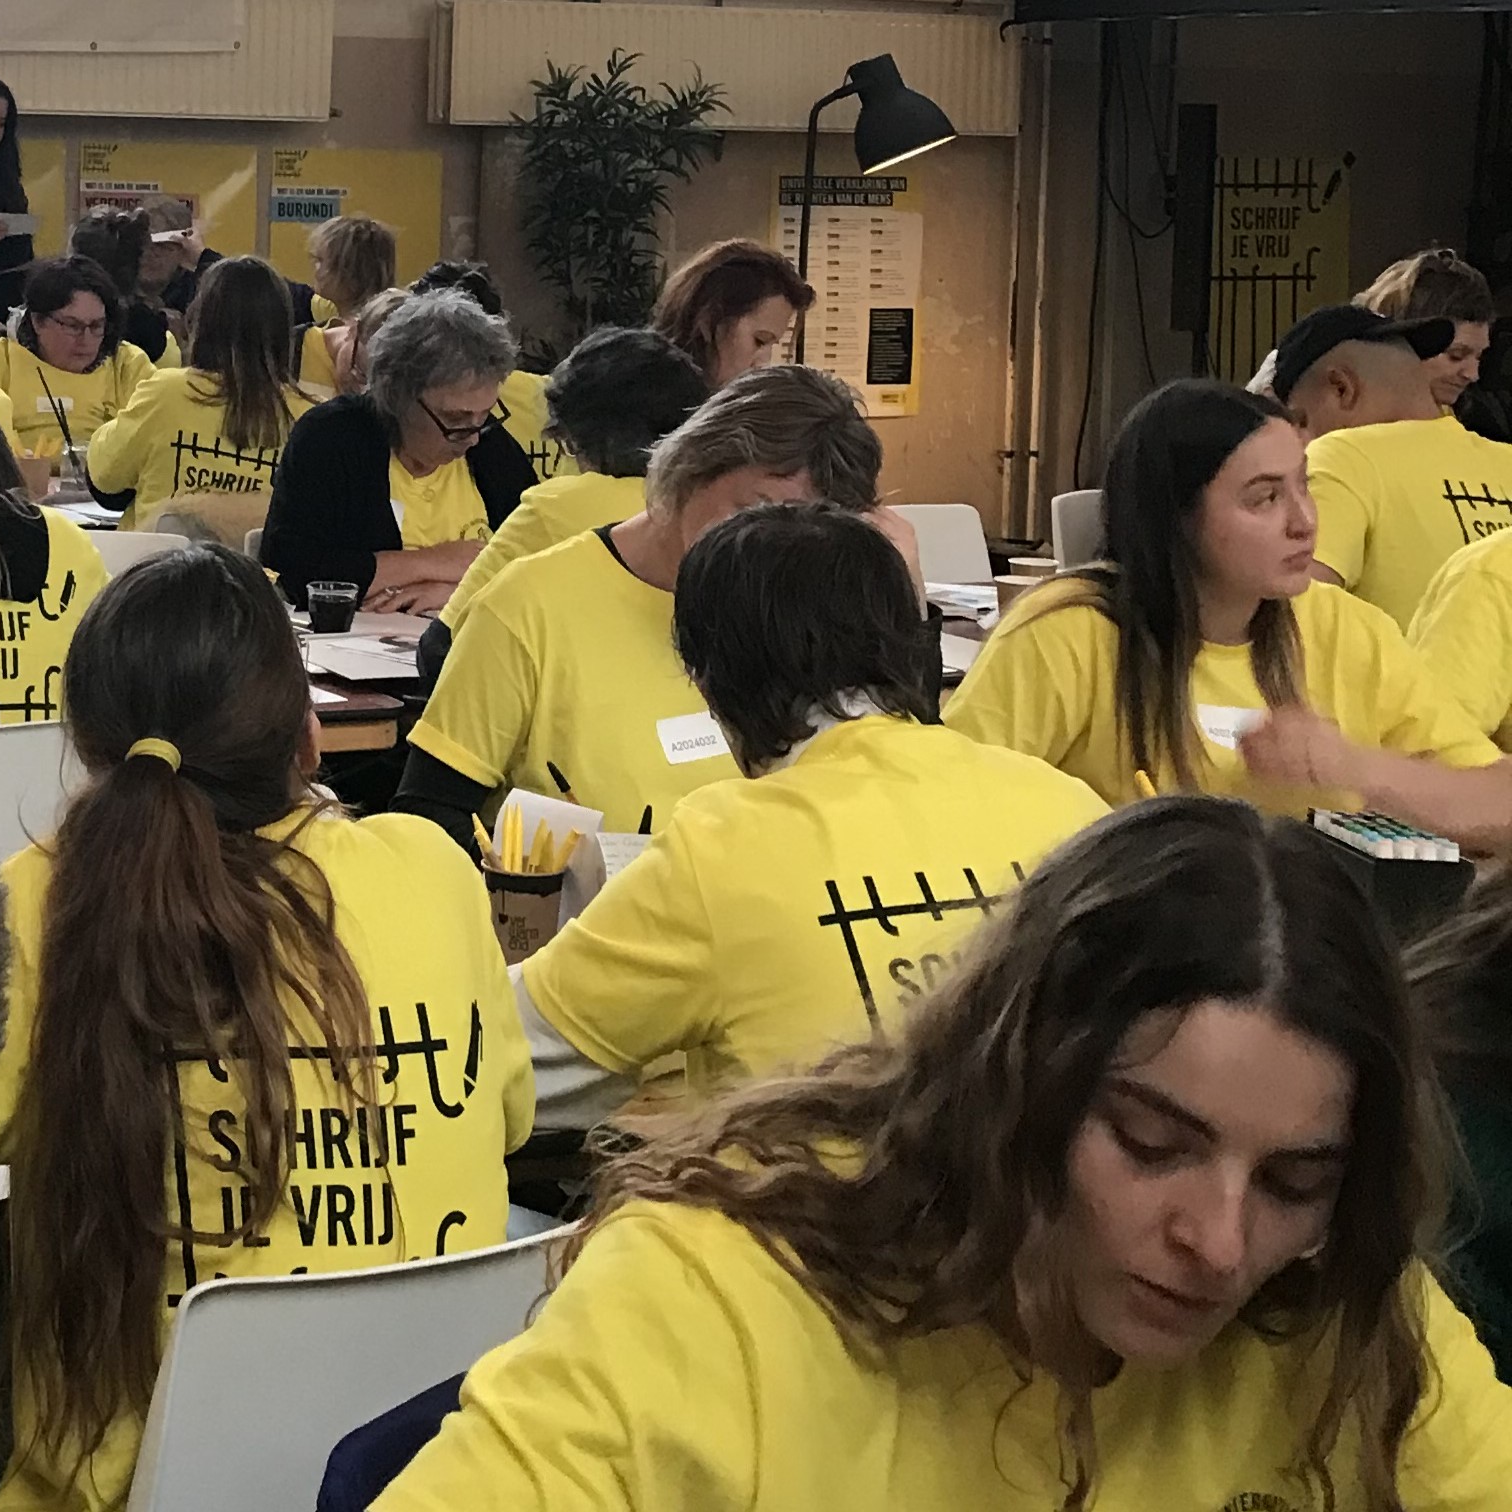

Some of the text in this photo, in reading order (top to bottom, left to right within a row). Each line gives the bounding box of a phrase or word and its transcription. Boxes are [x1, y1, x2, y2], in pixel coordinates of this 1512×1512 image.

[781, 178, 833, 189] UNIVSELE
[781, 192, 892, 204] DE RHTEN VAN DE MENS
[277, 201, 334, 218] BURUNDI
[1230, 206, 1301, 230] SCHRIJF
[1231, 234, 1290, 258] JE VRIJ
[671, 735, 718, 752] A2024032
[208, 1104, 417, 1172] SHRIJF
[290, 1182, 394, 1247] VRIJ
